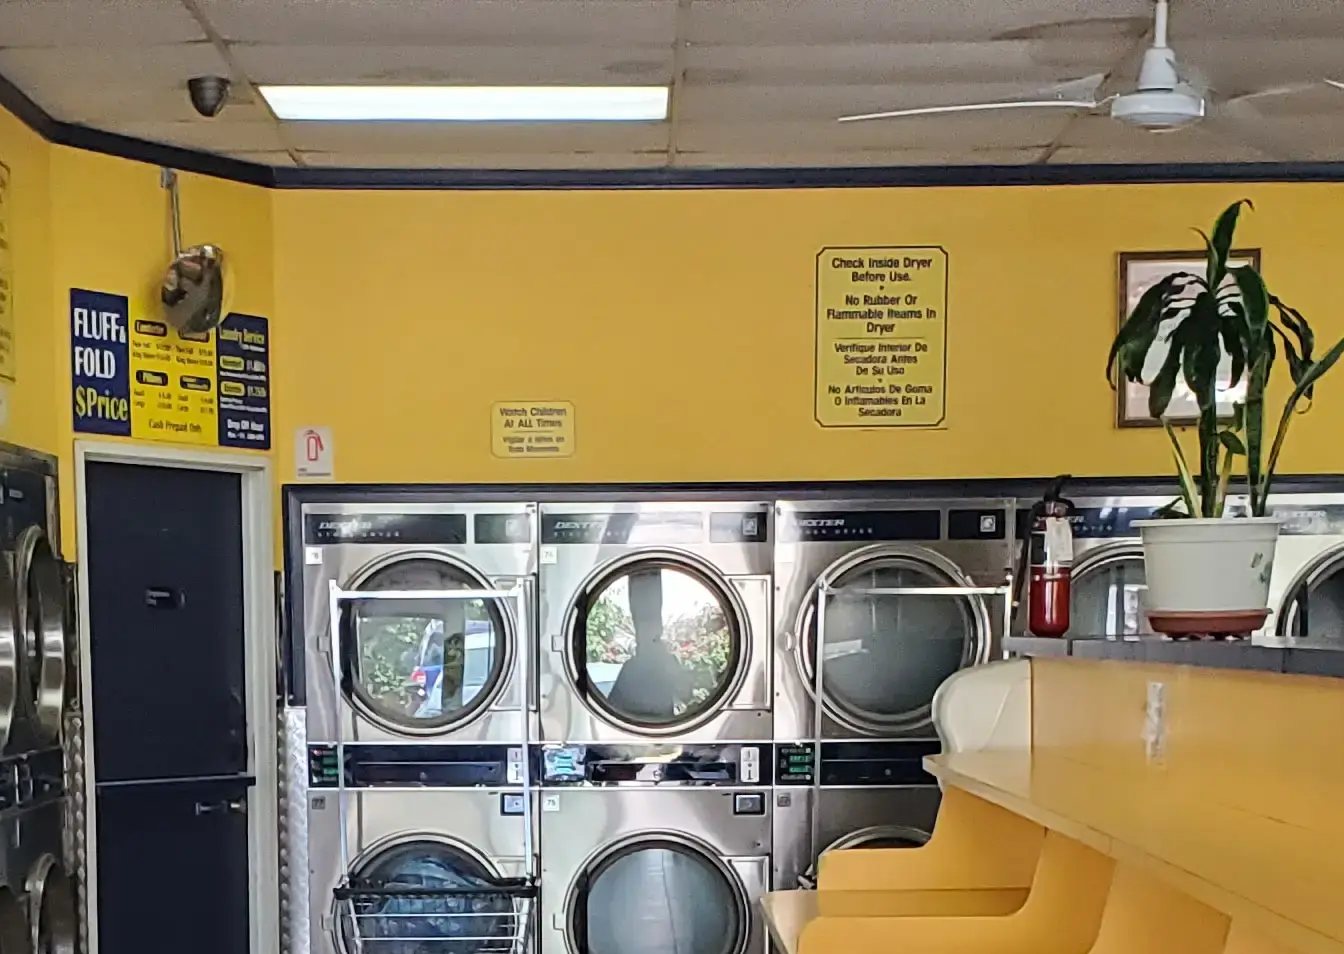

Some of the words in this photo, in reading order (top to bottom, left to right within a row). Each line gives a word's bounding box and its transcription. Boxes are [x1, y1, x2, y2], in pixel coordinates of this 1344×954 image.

[831, 257, 864, 269] Check
[868, 257, 900, 269] Inside
[903, 257, 933, 270] Dryer
[851, 271, 886, 282] Before
[889, 271, 911, 282] Use.
[845, 294, 860, 306] No
[863, 294, 901, 306] Rubber
[904, 294, 918, 306] Or
[827, 308, 884, 320] Flammable
[926, 308, 937, 319] In
[866, 322, 896, 335] Dryer
[834, 343, 876, 353] Verifique
[878, 343, 911, 352] Interior
[914, 342, 928, 352] De
[74, 346, 116, 379] FOLD
[843, 355, 887, 364] Secadora
[890, 354, 918, 364] Antes
[856, 366, 869, 376] De
[871, 366, 884, 376] Su
[886, 366, 905, 375] Uso
[828, 385, 841, 394] No
[889, 384, 902, 394] De
[904, 384, 933, 394] Goma
[75, 384, 129, 421] $Price
[844, 396, 899, 406] Inflamables
[901, 396, 913, 406] En
[914, 395, 926, 405] La
[530, 407, 567, 417] Children
[858, 407, 902, 417] Secadora
[149, 419, 163, 429] Cash
